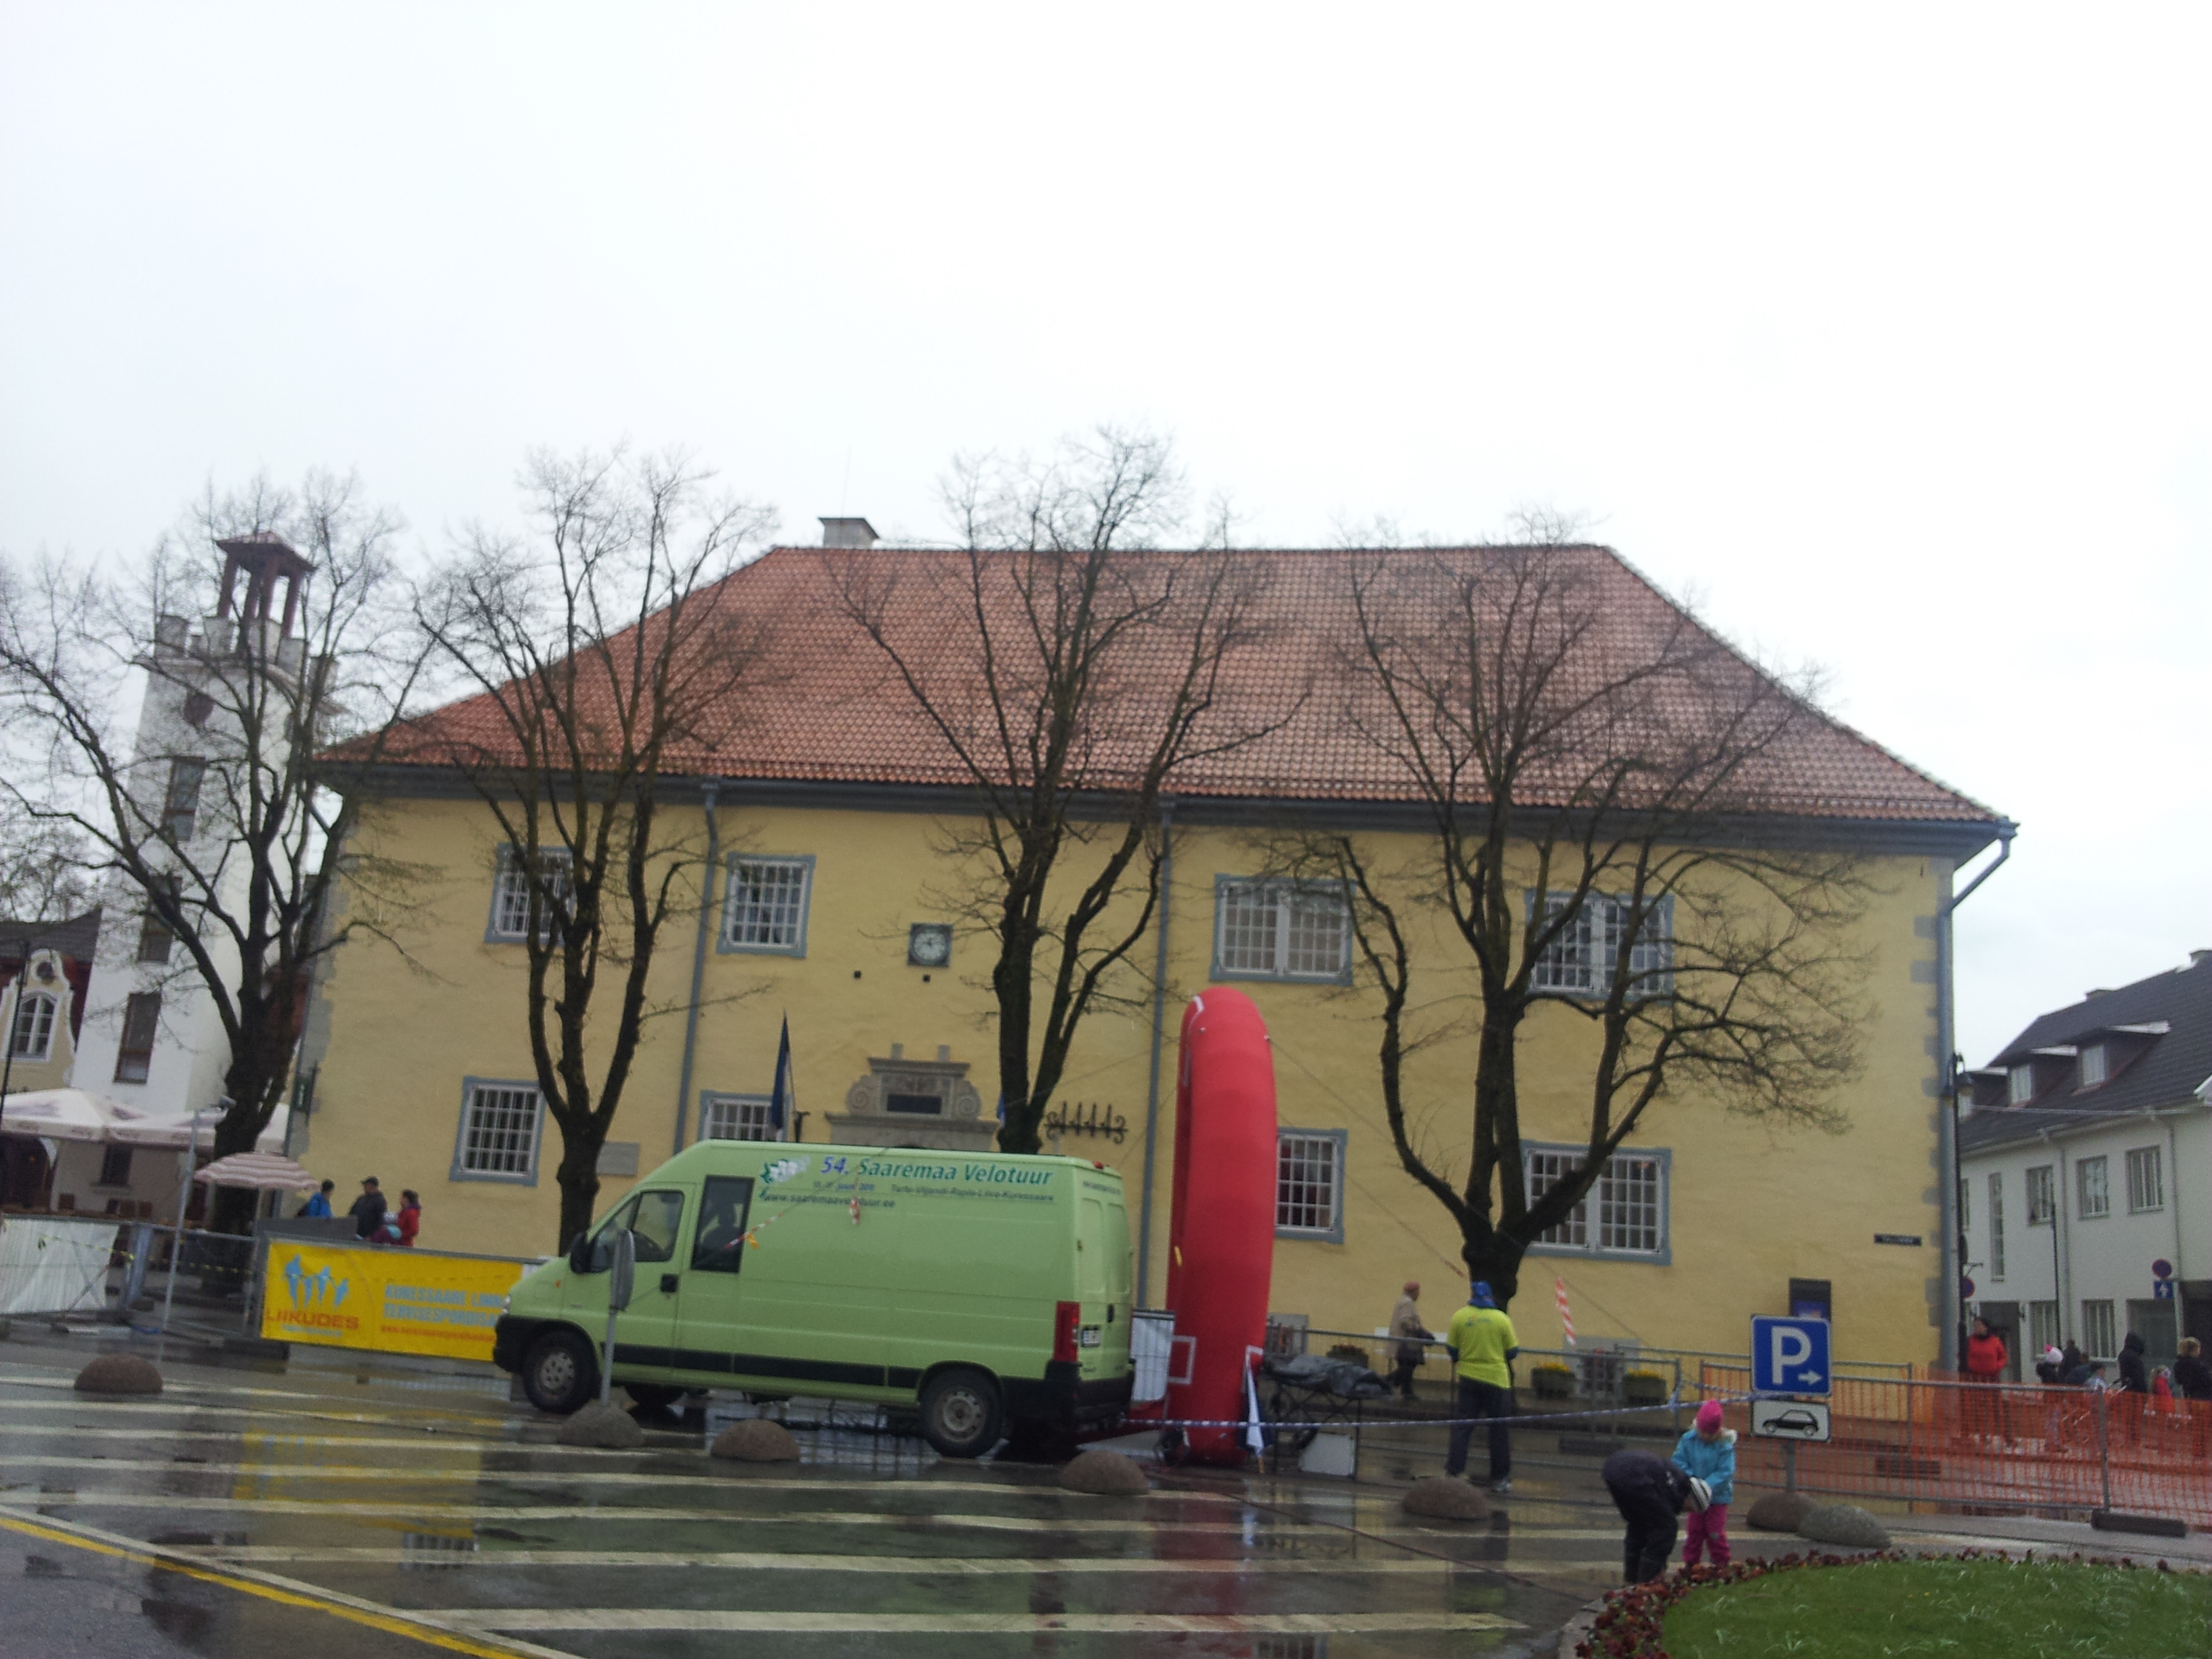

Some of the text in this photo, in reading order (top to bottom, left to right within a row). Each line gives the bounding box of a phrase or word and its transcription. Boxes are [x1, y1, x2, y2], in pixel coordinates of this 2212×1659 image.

[821, 1156, 1053, 1185] 54. Saaremaa Velotuur
[1771, 1326, 1812, 1384] P
